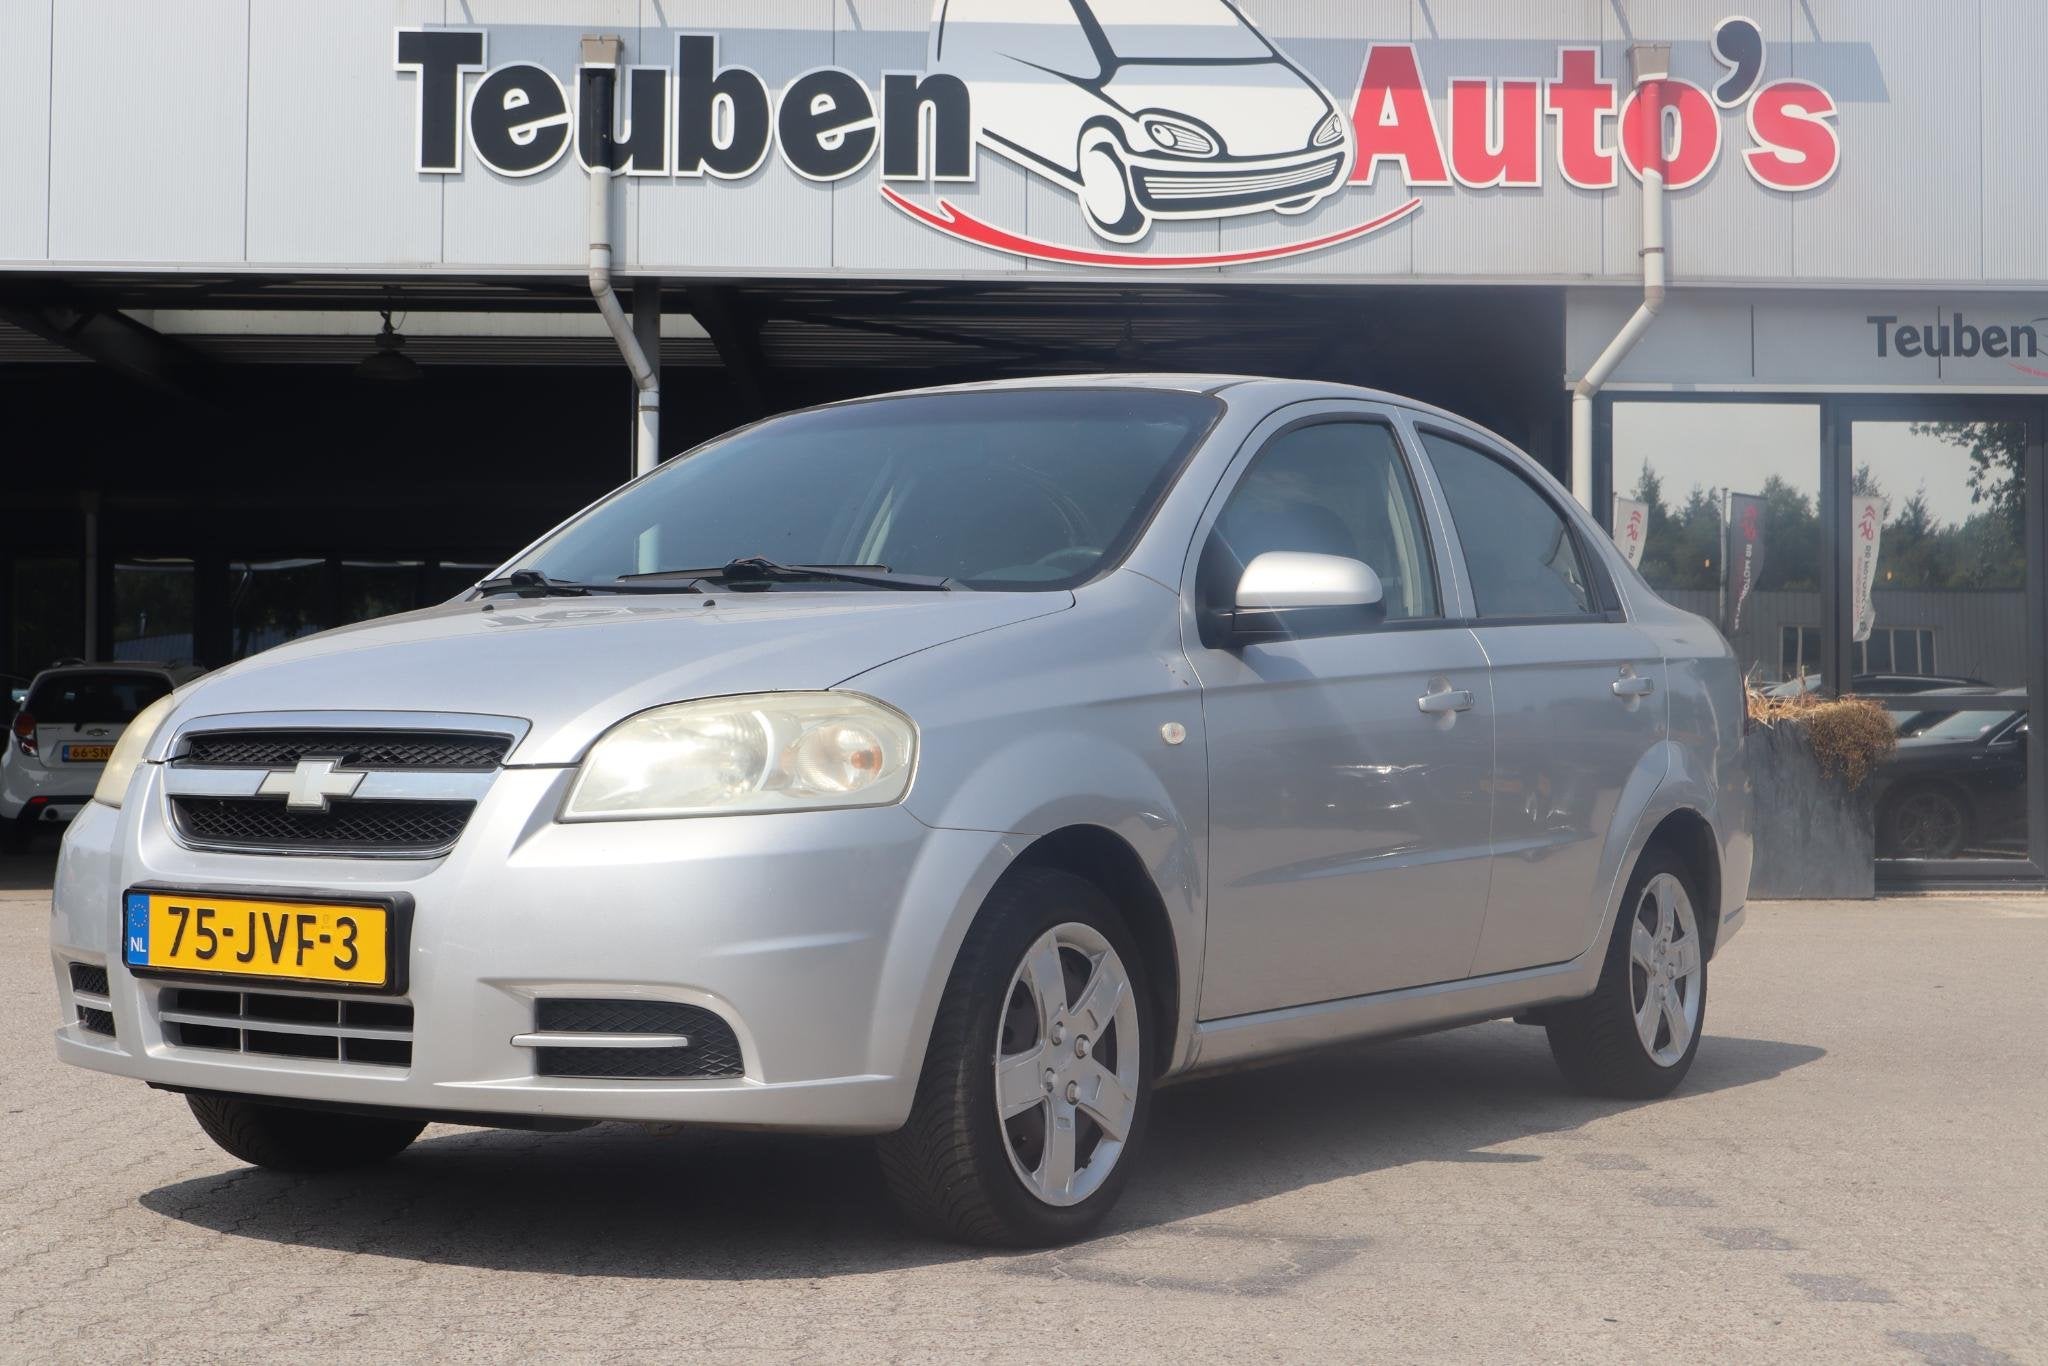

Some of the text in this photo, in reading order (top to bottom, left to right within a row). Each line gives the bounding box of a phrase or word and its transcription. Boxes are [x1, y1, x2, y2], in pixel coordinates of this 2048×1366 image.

[396, 17, 1839, 189] Teuben Auto's
[1866, 312, 2037, 358] Teuben
[130, 936, 147, 953] NL
[167, 906, 359, 971] 75-JVF-3
